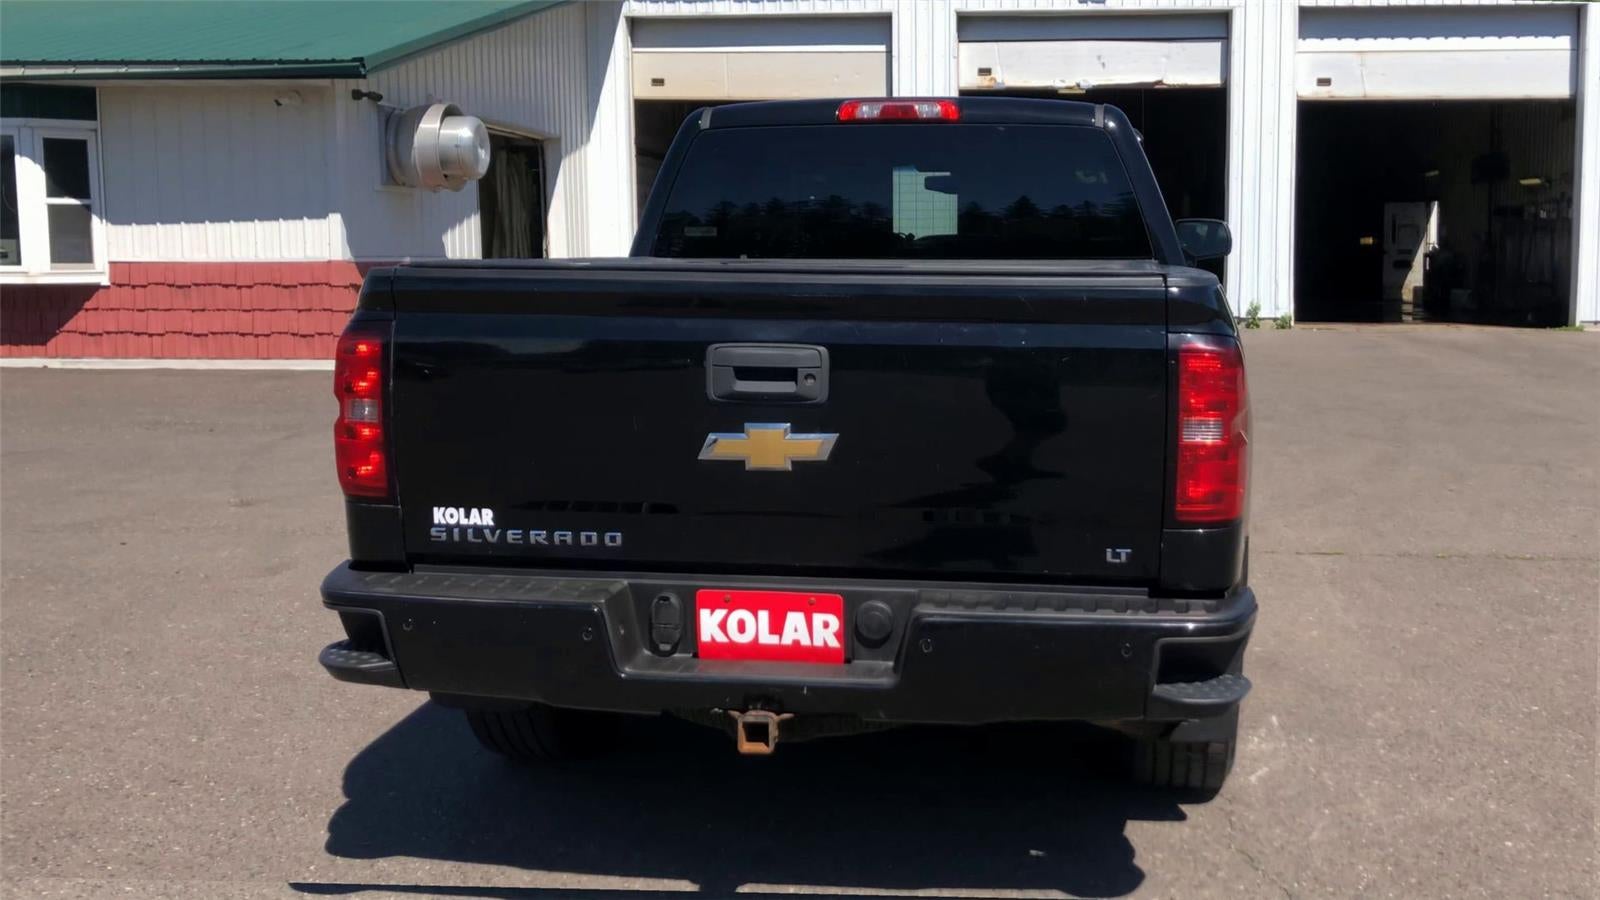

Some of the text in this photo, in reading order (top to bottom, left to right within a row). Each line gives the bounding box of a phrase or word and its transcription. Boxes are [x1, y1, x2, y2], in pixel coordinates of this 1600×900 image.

[433, 506, 494, 526] KOLAR
[430, 527, 623, 547] SILVERADO
[1106, 548, 1132, 563] LT
[699, 608, 841, 648] KOLAR
